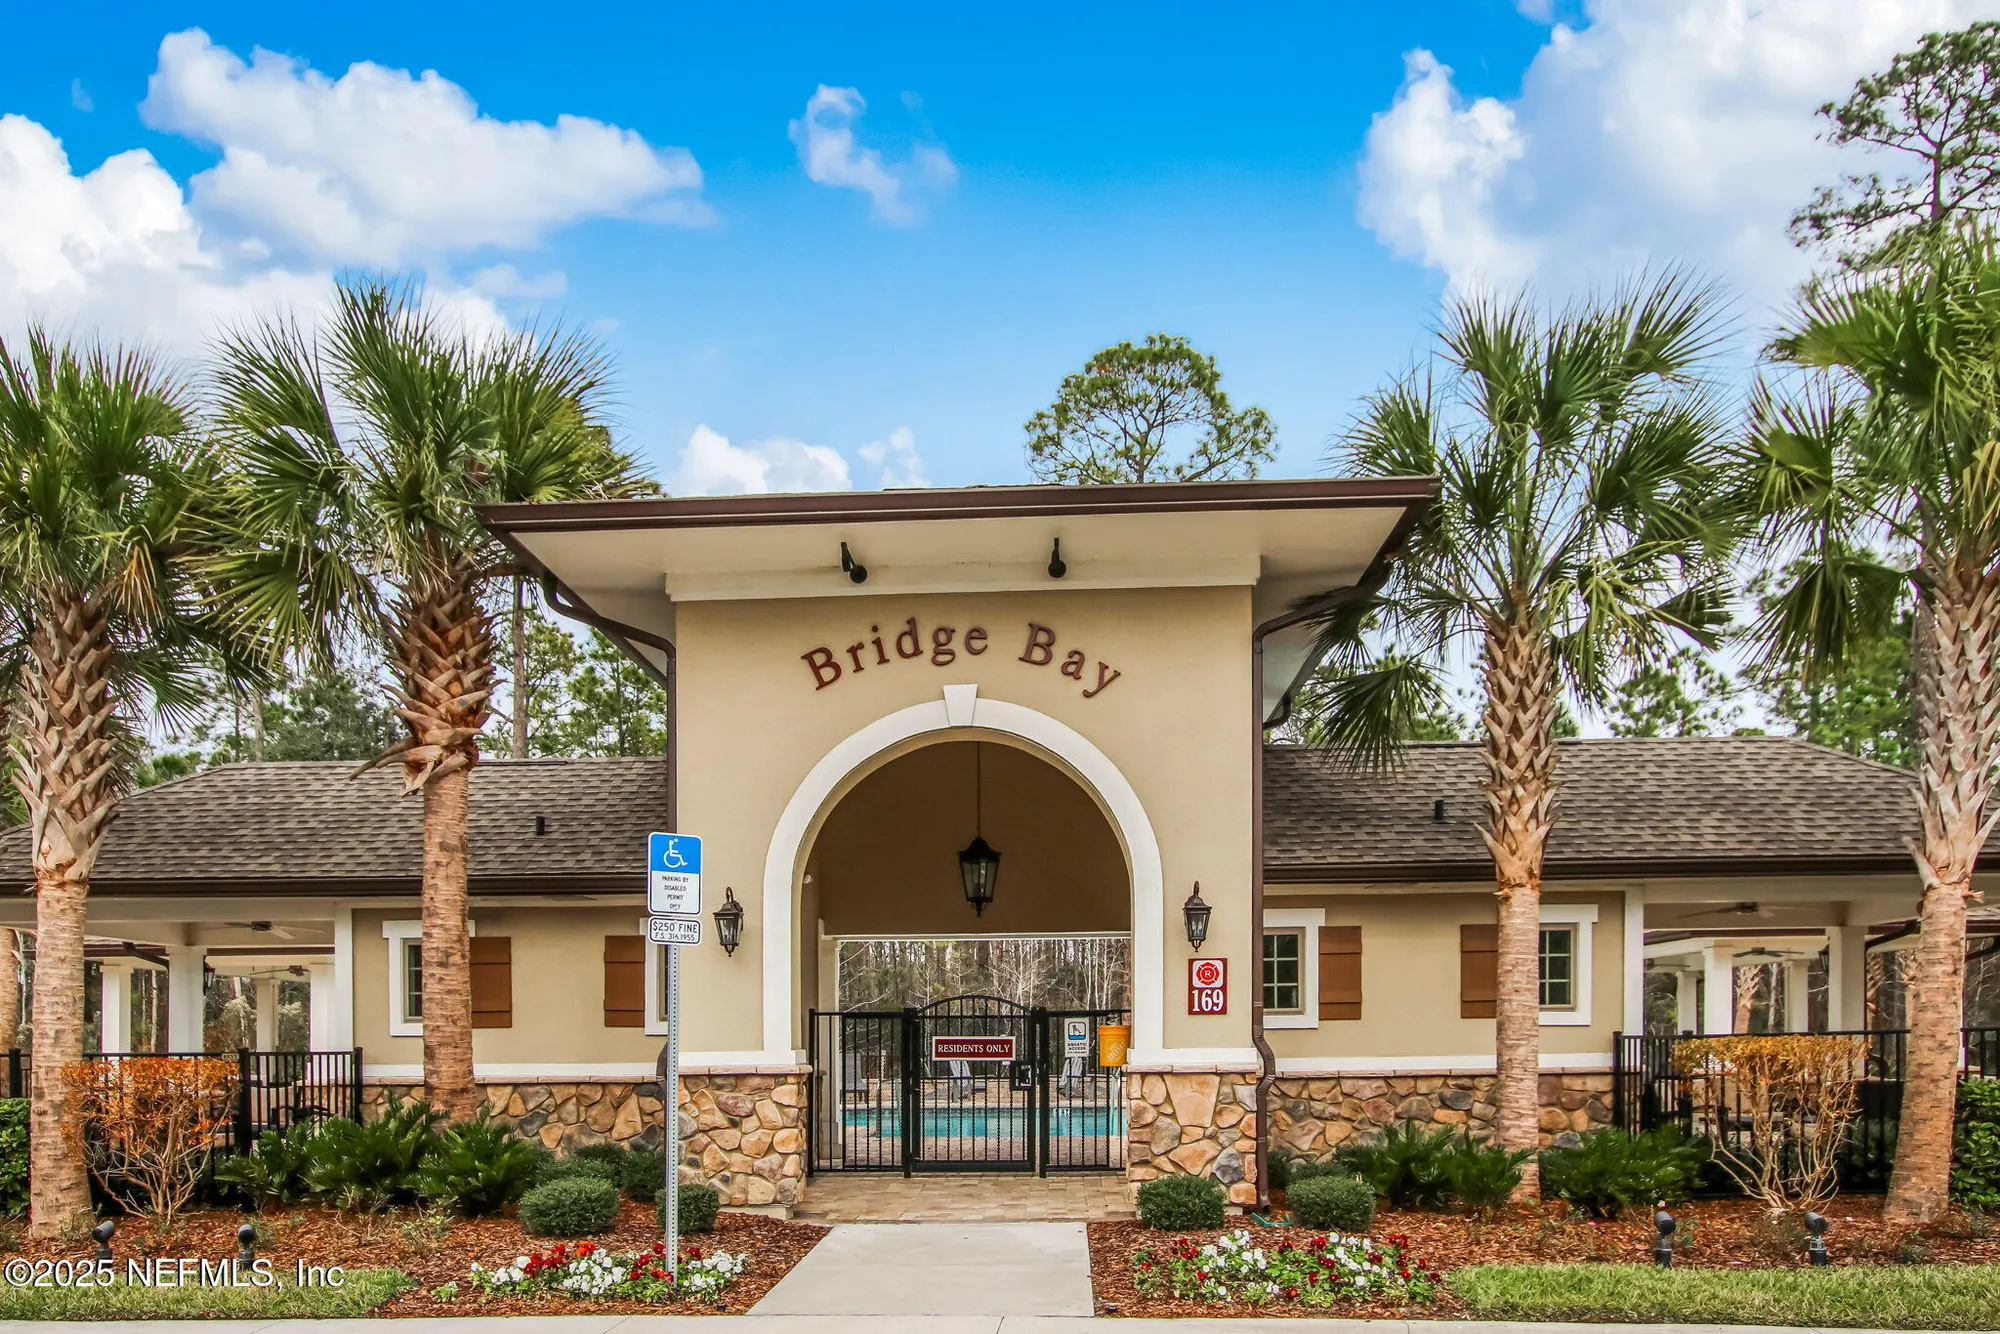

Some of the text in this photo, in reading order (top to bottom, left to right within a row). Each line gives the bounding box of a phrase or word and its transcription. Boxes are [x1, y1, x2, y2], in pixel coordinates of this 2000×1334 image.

[800, 616, 1121, 698] Bridge Bay
[653, 921, 698, 933] $250 FINE
[1192, 989, 1223, 1011] 169
[938, 1044, 1011, 1052] RESIDENTS ONLY
